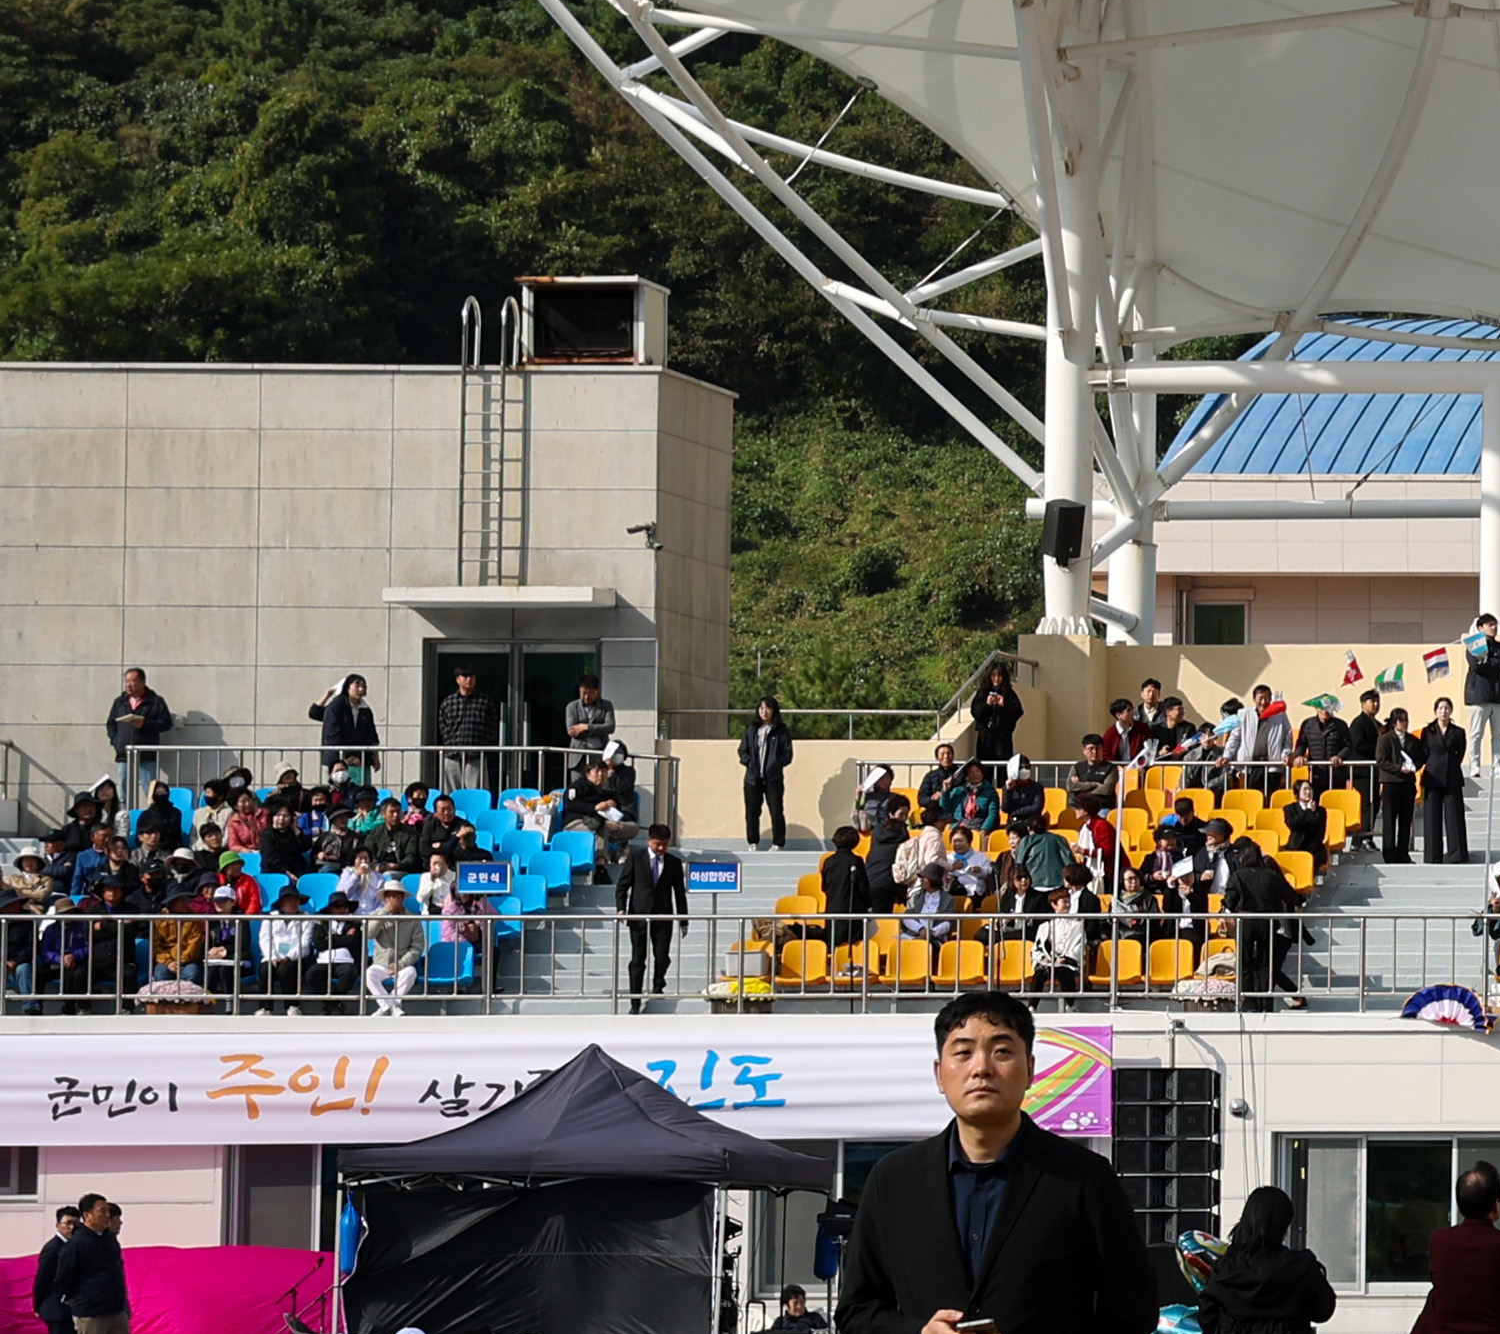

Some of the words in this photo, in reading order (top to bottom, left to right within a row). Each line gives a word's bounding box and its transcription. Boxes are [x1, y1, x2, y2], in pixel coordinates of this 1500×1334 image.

[47, 1076, 178, 1121] 군민이
[205, 1053, 390, 1120] 주인!
[646, 1049, 787, 1111] 진도
